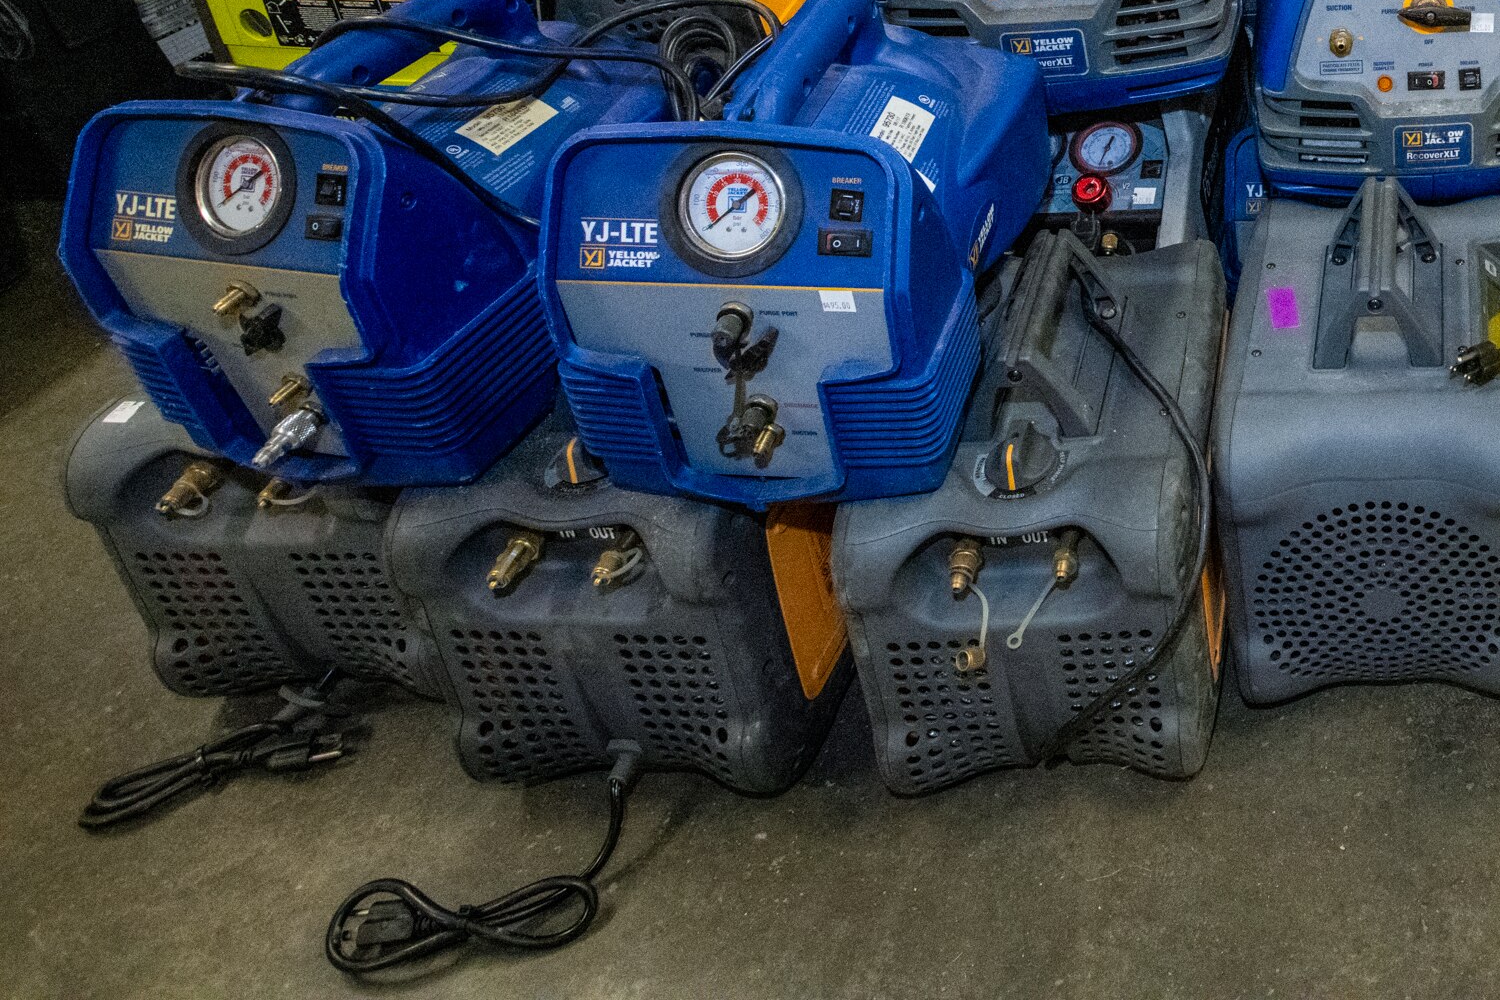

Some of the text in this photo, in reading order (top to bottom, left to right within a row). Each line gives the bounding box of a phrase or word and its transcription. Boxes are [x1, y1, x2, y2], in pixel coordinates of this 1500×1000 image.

[1326, 4, 1352, 12] SUCTION
[1013, 36, 1074, 53] YJ YELLOW
[1034, 44, 1072, 53] JACKET
[1039, 57, 1073, 67] verXLT
[1405, 133, 1421, 146] YJ
[1425, 136, 1460, 145] JACET
[1406, 150, 1460, 161] RecoverXLT
[322, 163, 348, 171] BREAKER
[832, 177, 863, 185] BREAKER
[1057, 176, 1070, 184] JB
[116, 193, 176, 220] YJ-LTE
[114, 220, 173, 238] YJ YELLOW
[581, 220, 658, 243] YJ-LTE
[132, 231, 171, 243] JACKET
[583, 249, 657, 266] YJ YELLOW
[607, 258, 653, 268] JACKET
[998, 492, 1025, 500] CLOSED
[589, 527, 615, 539] OUT
[1022, 530, 1049, 543] OUT
